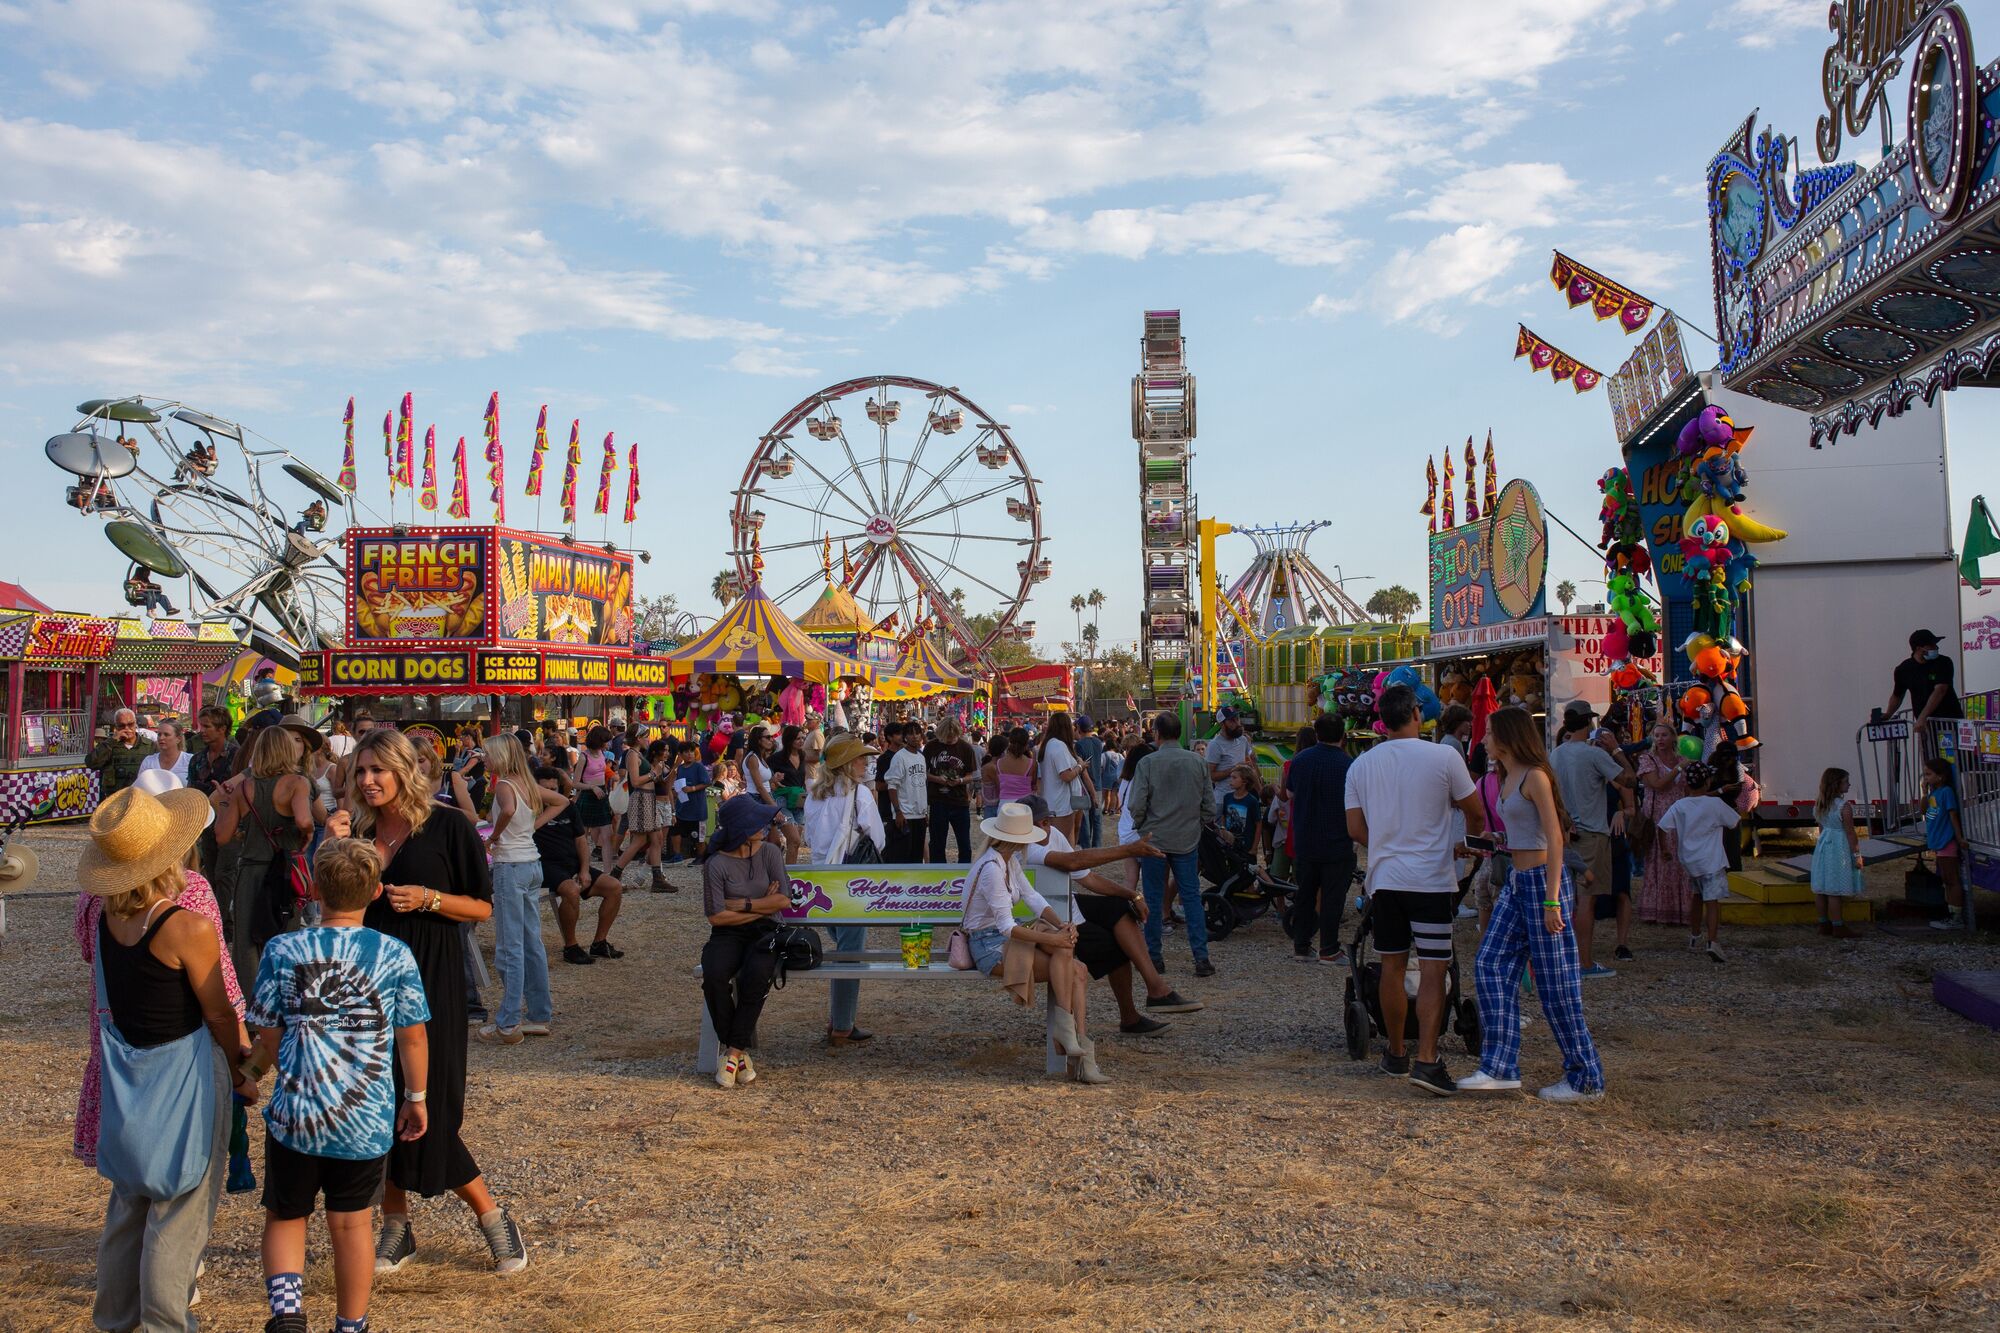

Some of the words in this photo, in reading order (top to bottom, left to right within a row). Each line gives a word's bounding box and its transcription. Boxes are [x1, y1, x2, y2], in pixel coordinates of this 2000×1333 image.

[363, 542, 477, 567] FRENCH
[1433, 528, 1490, 588] SHOOT
[380, 566, 460, 589] FRIES
[532, 552, 572, 593] PAPA'S
[574, 561, 608, 601] PAPAS
[1440, 581, 1485, 630] OUT
[1432, 632, 1456, 648] THANK
[1458, 631, 1472, 645] YOU
[1472, 629, 1487, 643] FOR
[1489, 625, 1510, 641] YOUR
[1513, 620, 1547, 639] SERVICE
[335, 658, 397, 680] CORN
[403, 657, 465, 680] DOGS
[484, 656, 505, 668] ICE
[508, 656, 537, 668] COLD
[545, 659, 580, 681] FUNNEL
[581, 661, 609, 682] CAKES
[615, 662, 666, 684] NACHOS
[484, 668, 537, 681] DRINKS
[1868, 723, 1908, 740] ENTER
[908, 763, 925, 776] SMILE
[57, 787, 87, 811] CARS
[848, 877, 904, 896] Helm
[907, 879, 947, 897] and
[865, 896, 963, 912] Amusemen
